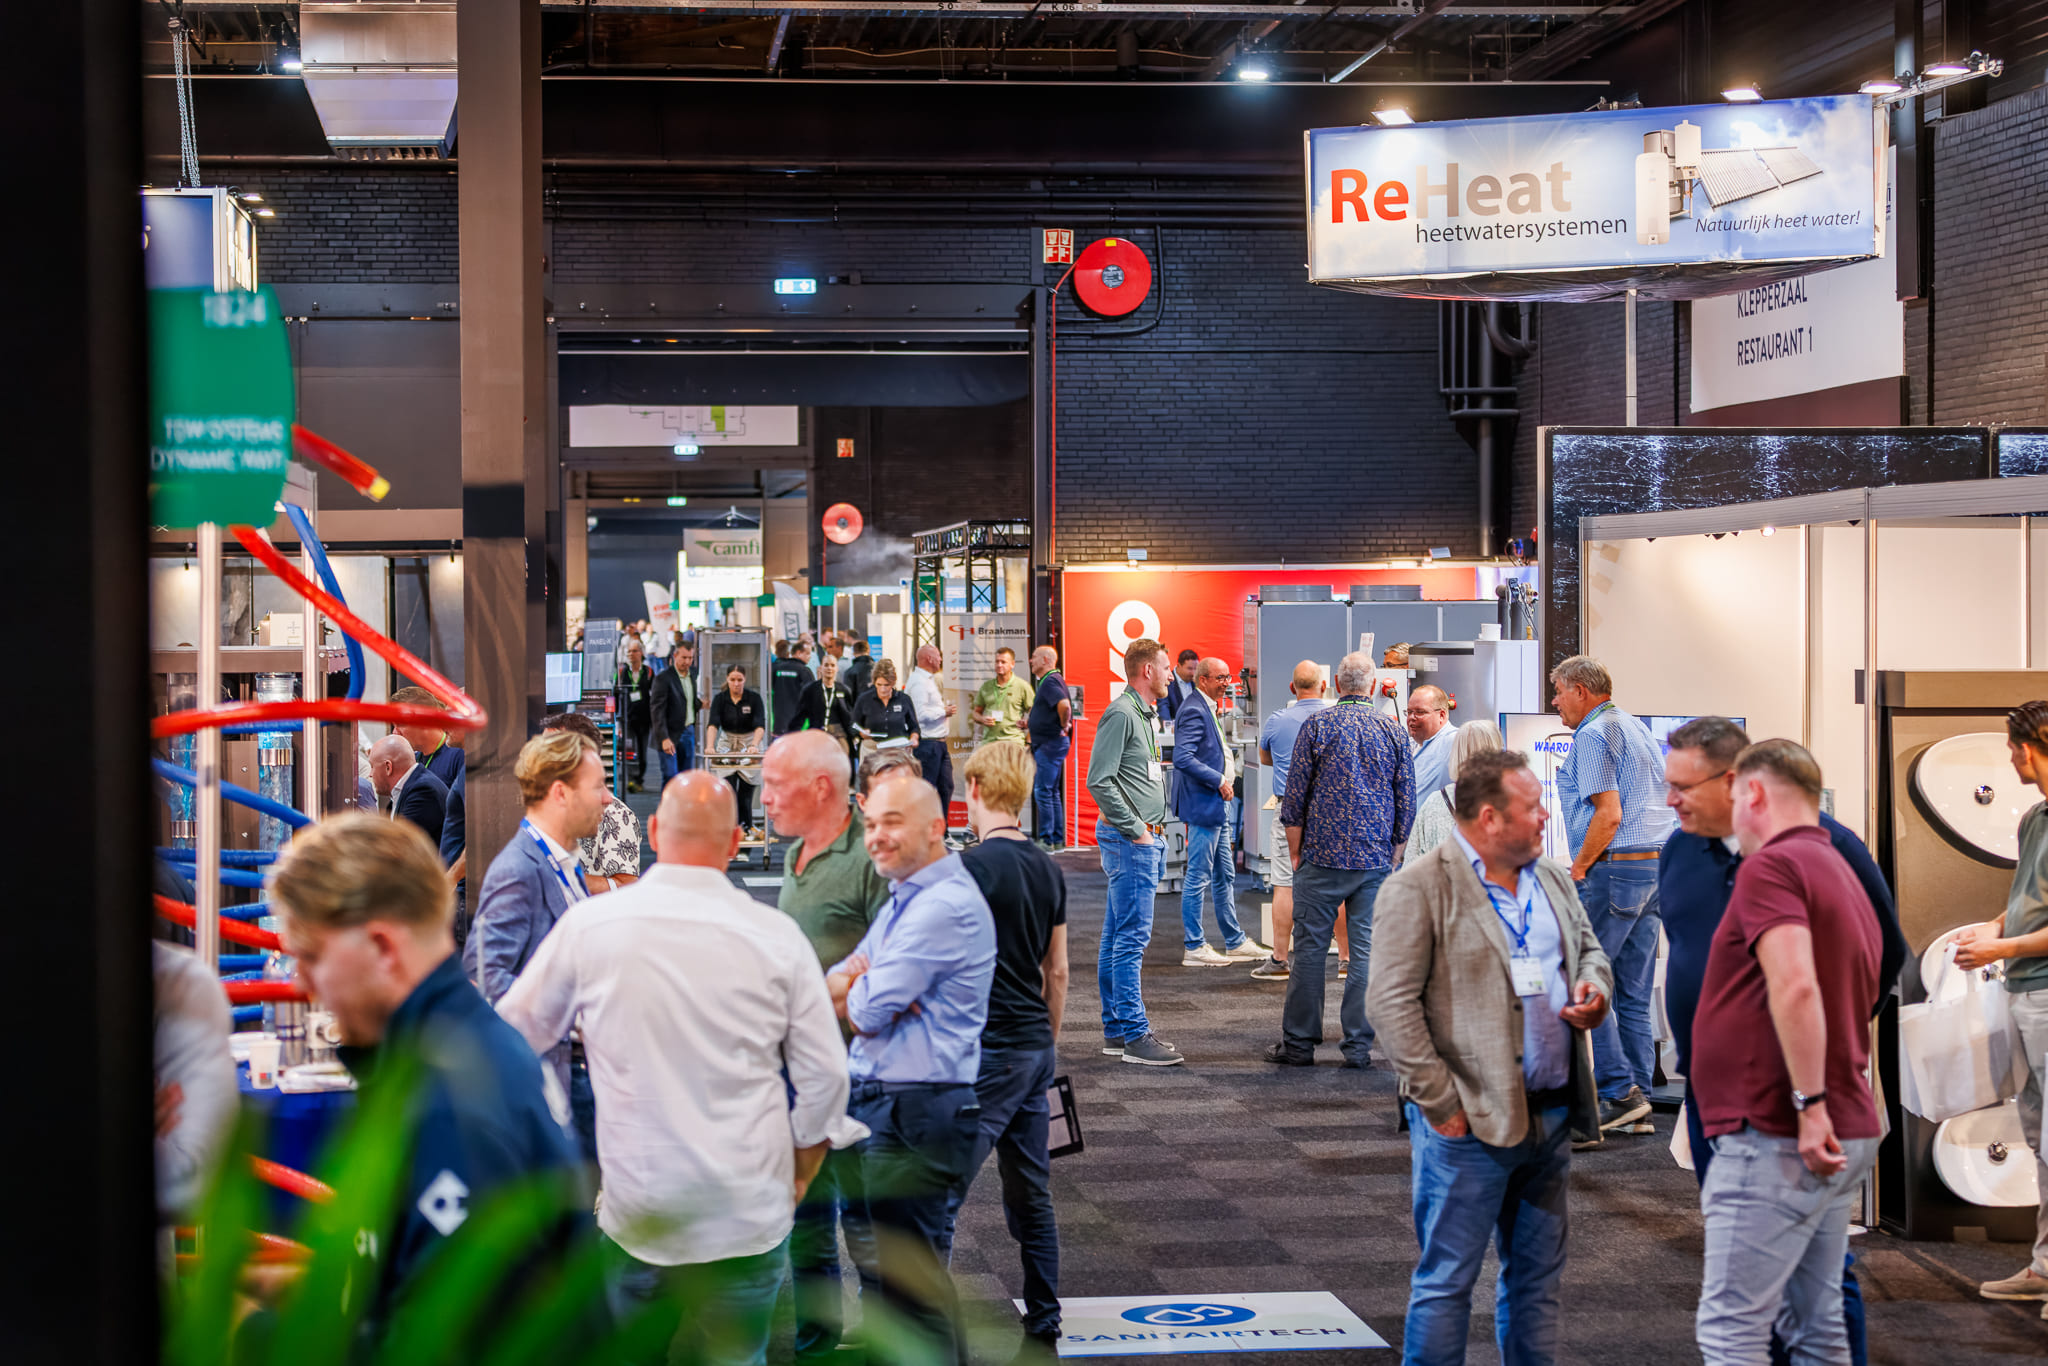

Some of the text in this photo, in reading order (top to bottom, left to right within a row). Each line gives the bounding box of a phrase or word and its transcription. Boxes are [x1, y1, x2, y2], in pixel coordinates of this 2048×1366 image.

[1331, 161, 1572, 223] ReHeat
[1416, 218, 1627, 243] heetwatersystemen
[1695, 210, 1861, 233] Natuurlijk heet water!
[1737, 276, 1808, 319] KLEPPERZAAL
[1737, 326, 1813, 366] RESTAURANT 1
[978, 627, 1026, 635] Braakman
[1066, 1327, 1347, 1343] SANITAIRTECH
